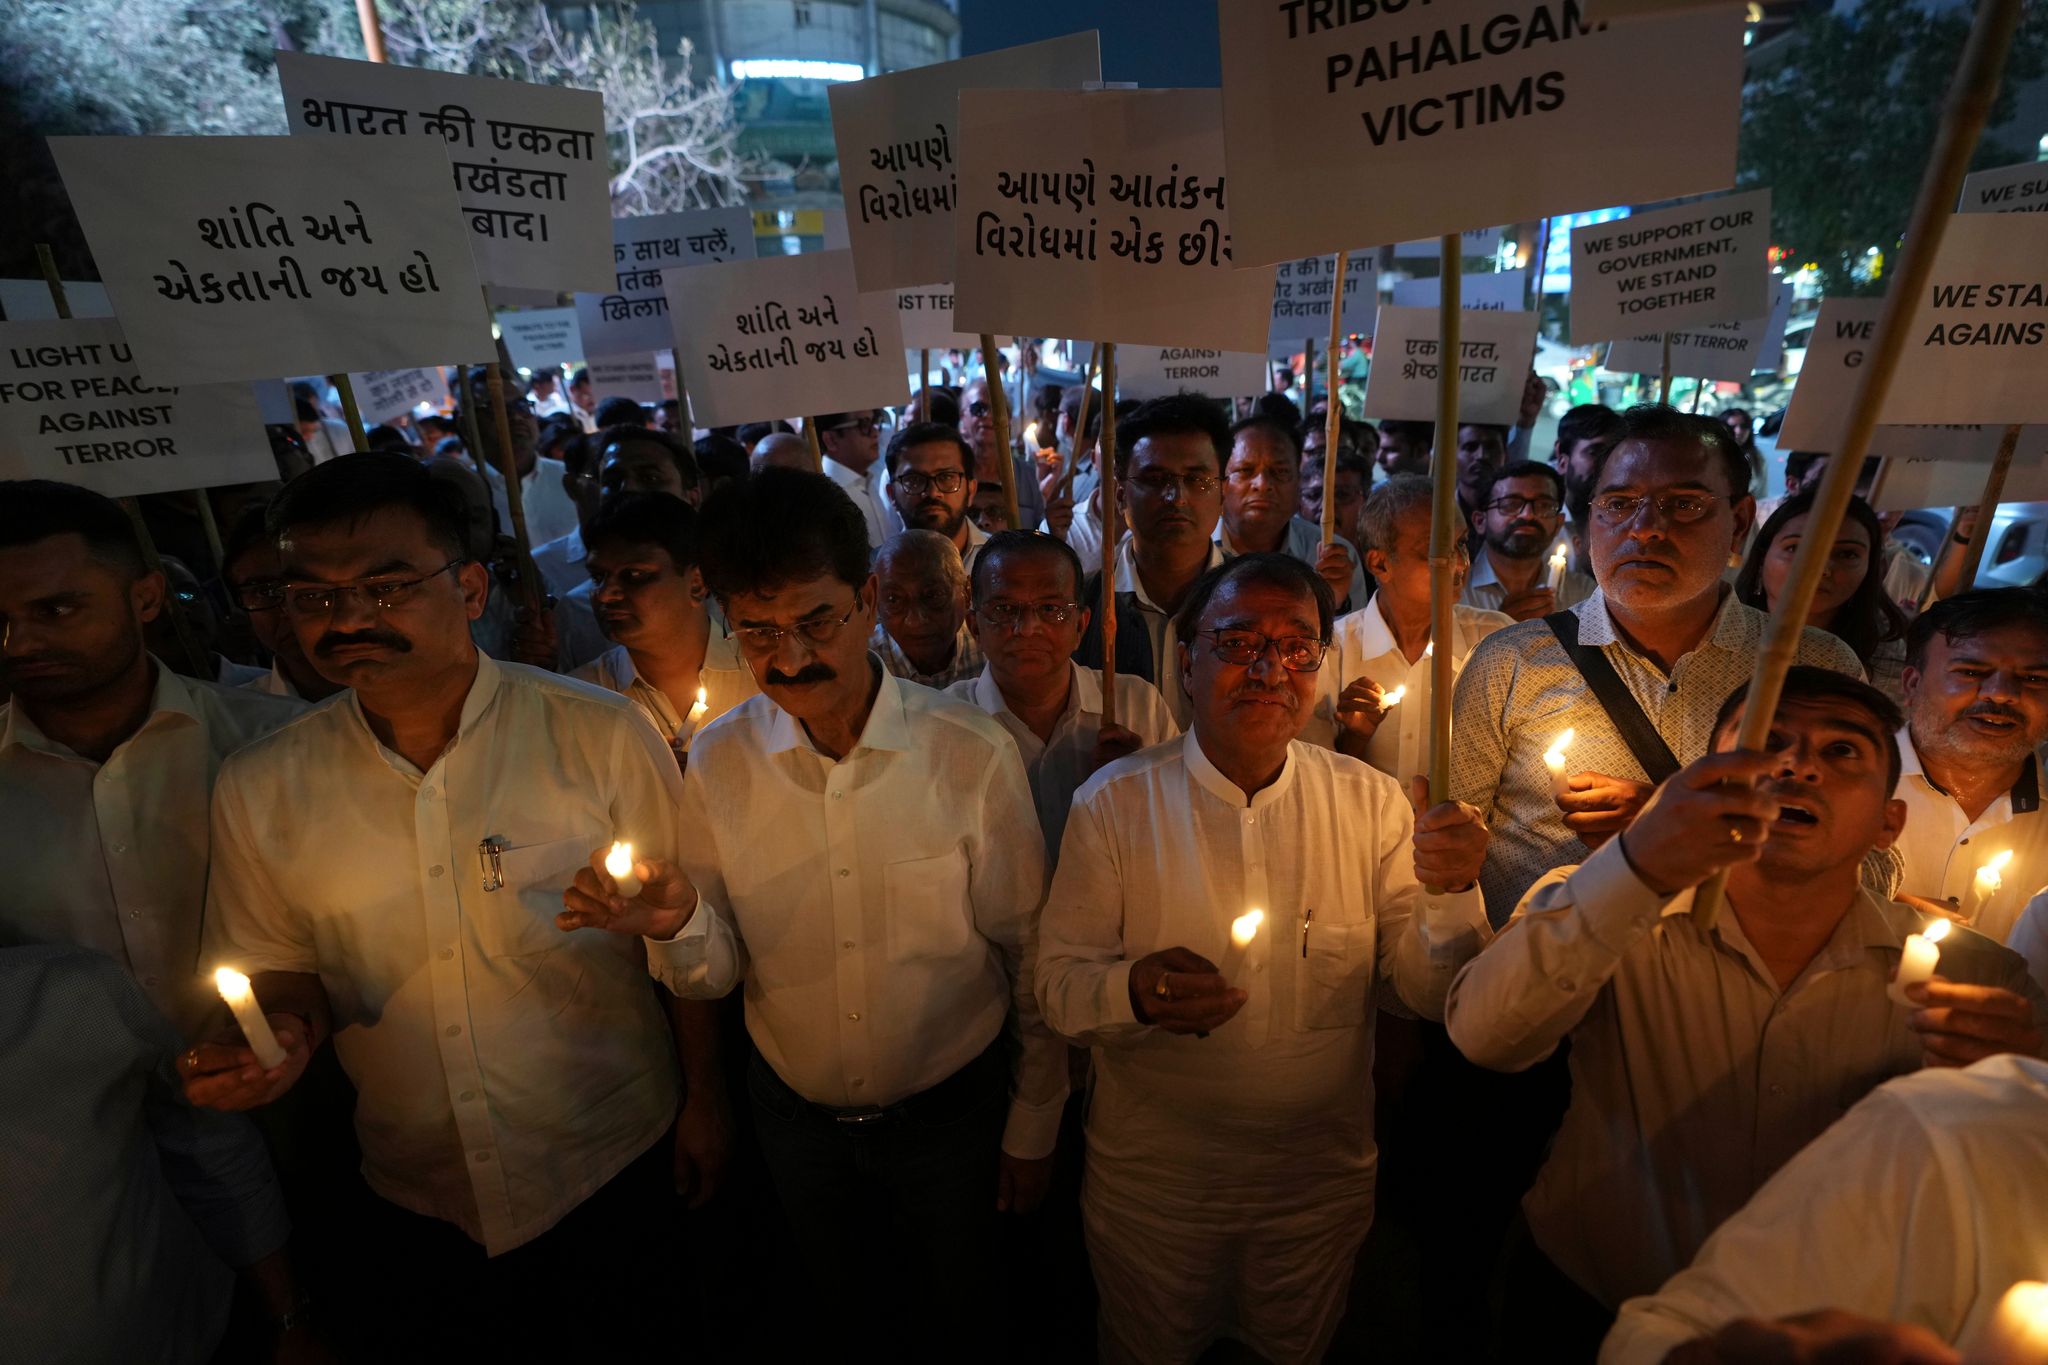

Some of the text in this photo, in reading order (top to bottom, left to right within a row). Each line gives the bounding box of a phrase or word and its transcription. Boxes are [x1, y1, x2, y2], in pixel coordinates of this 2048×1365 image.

[1362, 71, 1567, 147] VICTIMS
[303, 98, 595, 161] भारत की एकता
[870, 123, 952, 172] આપણે
[453, 157, 567, 201] खंडता
[997, 158, 1225, 214] આપણે આતંકન
[1981, 184, 2017, 205] WE
[197, 200, 373, 249] શાંતિ અને
[975, 211, 1098, 261] વિરોધમાં
[1110, 216, 1165, 265] એક
[1584, 210, 1754, 255] WE SUPPORT OUR
[632, 238, 680, 261] साथ
[686, 227, 736, 256] चलें,
[1598, 237, 1738, 275] GOVERNMENT,
[153, 250, 440, 304] એકતાની જય હો
[1617, 264, 1717, 294] WE STAND
[599, 295, 670, 322] खिला
[1617, 287, 1716, 315] TOGETHER
[1932, 284, 2048, 308] WE STA
[736, 295, 839, 336] શાંતિ અને
[1836, 320, 1876, 339] WE
[1405, 339, 1438, 356] एक
[1693, 335, 1749, 351] TERROR
[1924, 323, 2046, 346] AGAINS
[10, 343, 132, 369] LIGHT U
[708, 327, 880, 373] એકતાની જય હો
[1160, 347, 1222, 361] AGAINST
[1164, 366, 1220, 379] TERROR
[0, 380, 67, 404] FOR
[39, 405, 174, 435] AGAINST
[55, 437, 178, 465] TERROR
